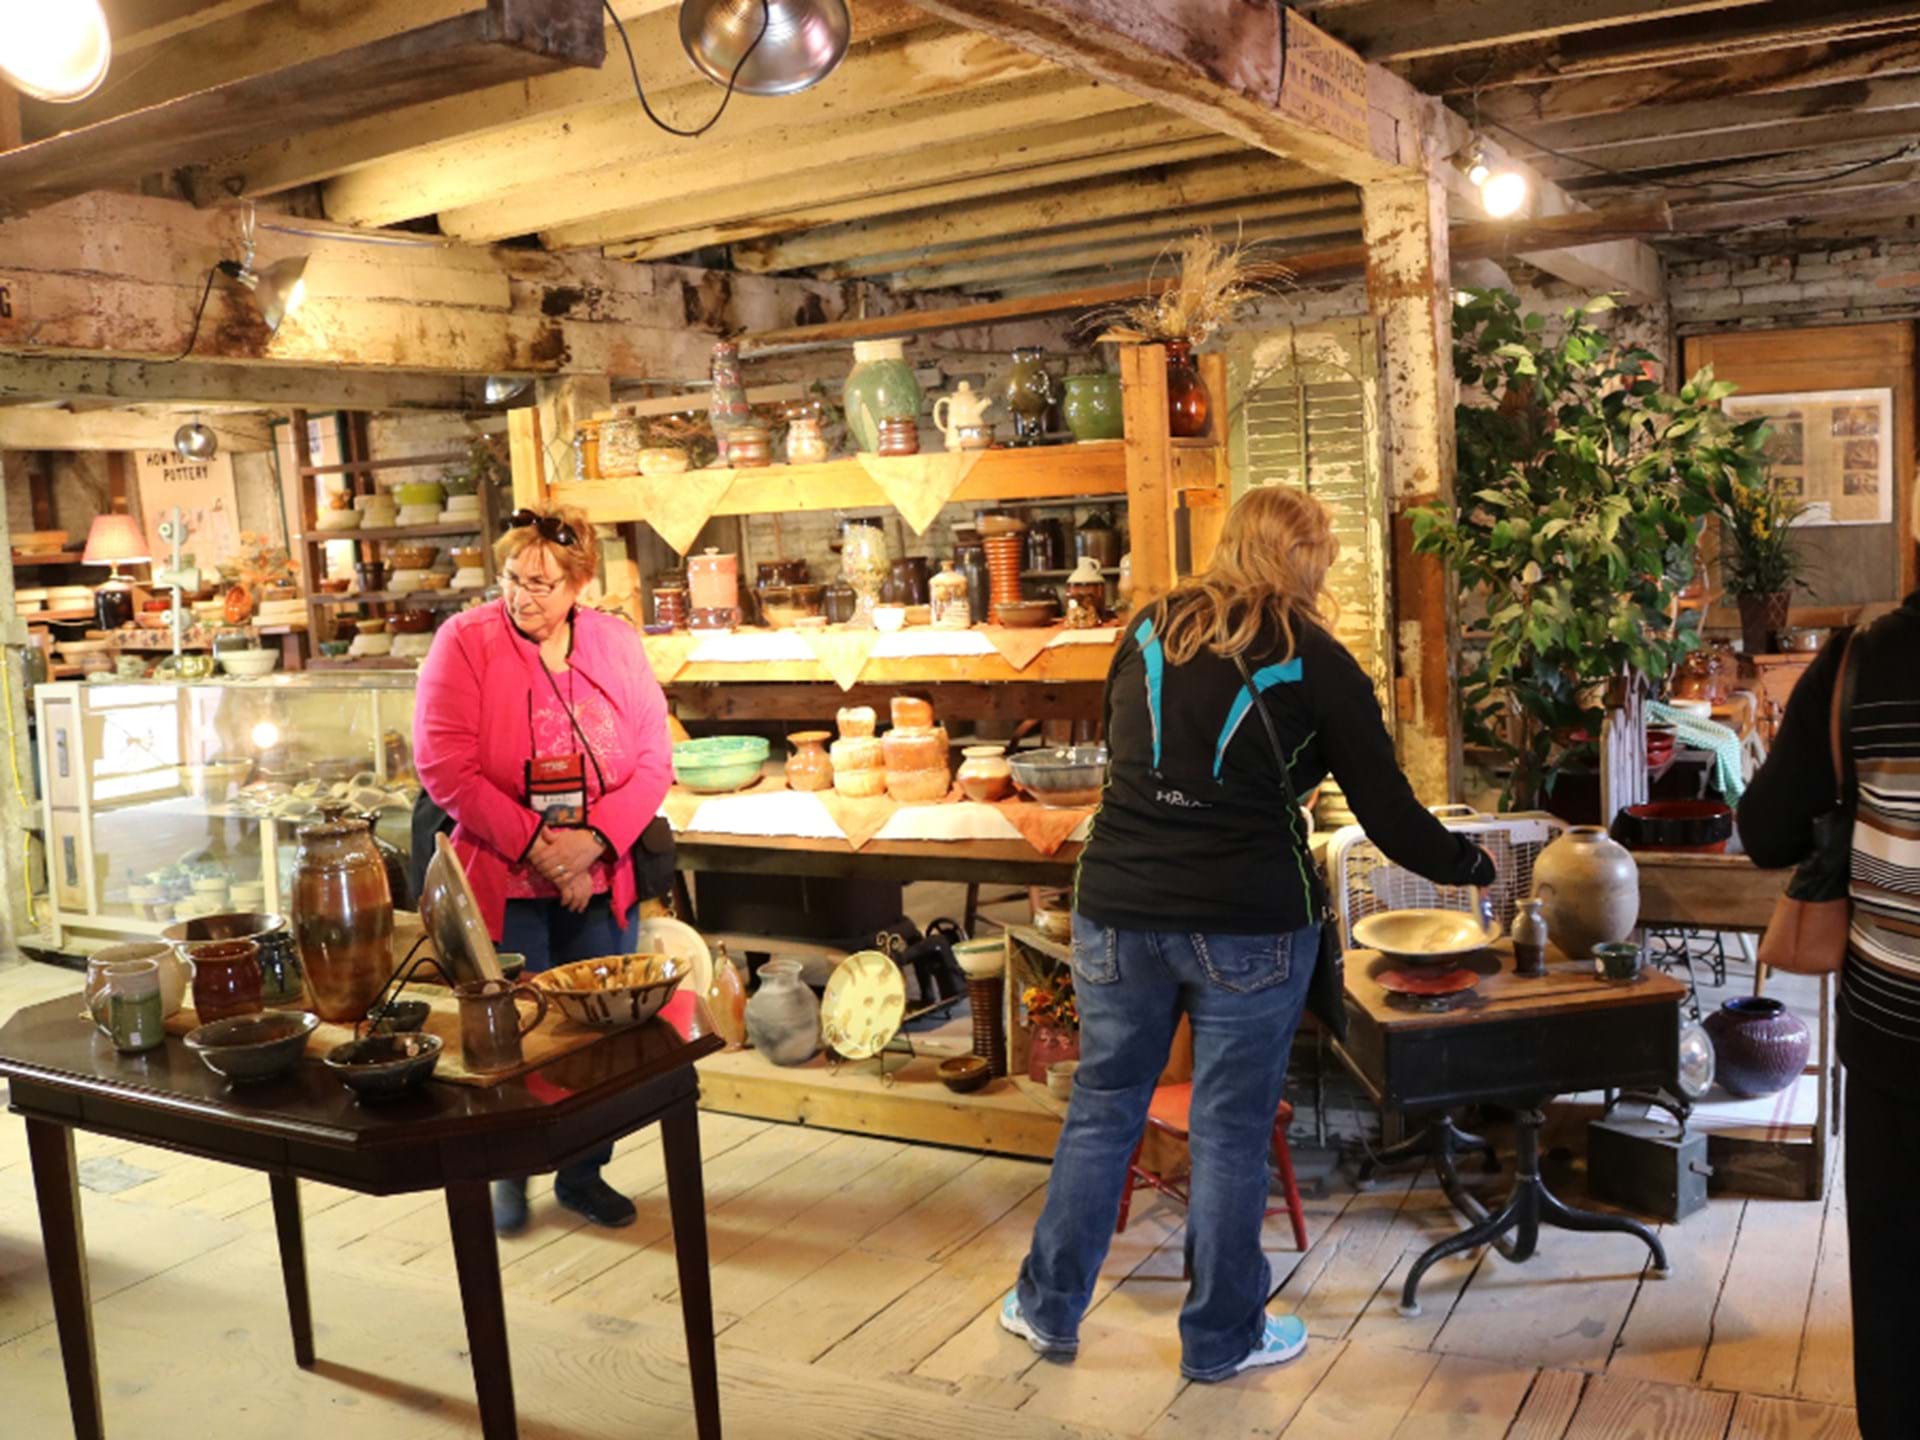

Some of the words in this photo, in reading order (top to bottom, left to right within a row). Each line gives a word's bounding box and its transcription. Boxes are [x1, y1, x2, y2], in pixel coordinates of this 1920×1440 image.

[146, 452, 167, 466] HOW
[171, 451, 184, 465] TO
[163, 466, 207, 481] POTTERY
